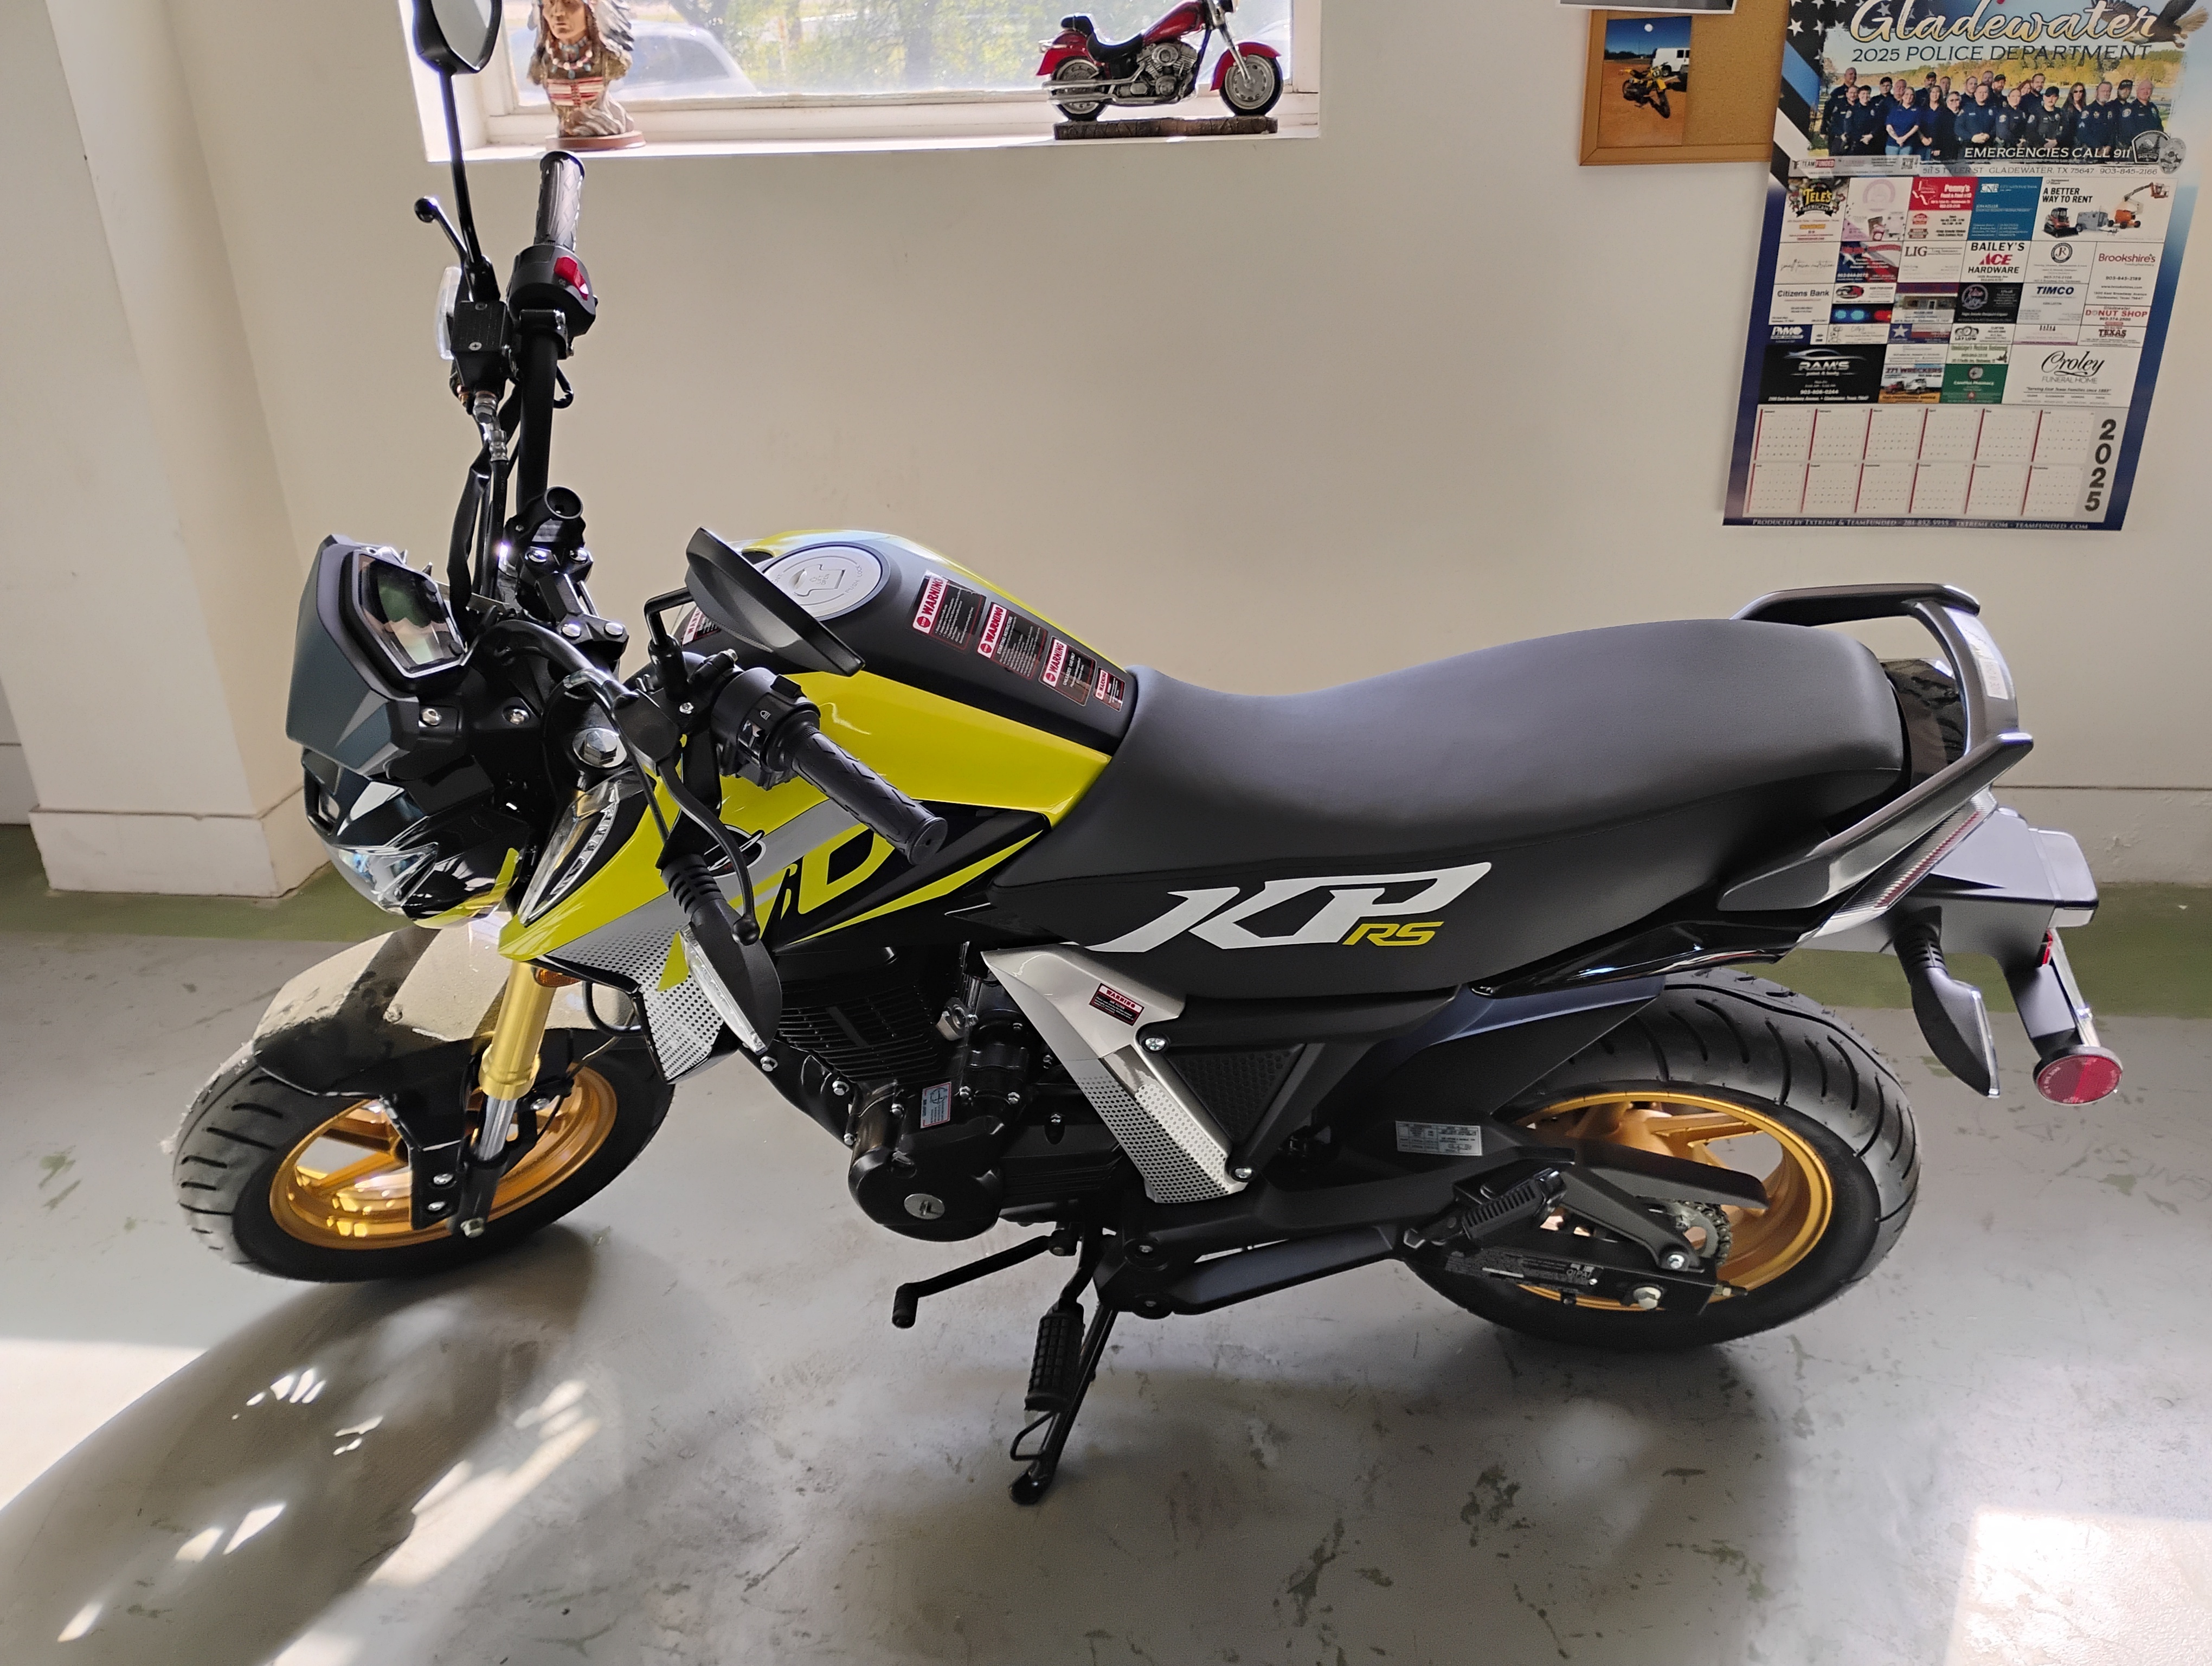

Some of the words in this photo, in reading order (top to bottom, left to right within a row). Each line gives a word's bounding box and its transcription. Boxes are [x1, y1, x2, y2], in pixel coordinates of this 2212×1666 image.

[1850, 0, 2158, 43] Gladewater
[1851, 48, 1900, 62] 2025
[1905, 46, 1984, 62] POLICE
[1990, 44, 2152, 60] DEPARTMENT
[1964, 147, 2069, 158] EMERGENCIES
[2072, 147, 2111, 158] CALL
[2113, 149, 2132, 158] 911
[1980, 184, 1999, 193] CNB
[2052, 188, 2080, 196] BETTER
[1904, 246, 1927, 257] LIG
[1970, 242, 2025, 252] BAILEY'S
[1979, 252, 2013, 265] ACE
[2098, 253, 2156, 263] Brookshire's
[2036, 286, 2074, 295] TIMCO
[1798, 360, 1850, 371] RAM'S
[2041, 350, 2105, 377] Croley
[2041, 375, 2073, 383] FUNERAL
[2085, 418, 2117, 512] 2025
[845, 580, 860, 593] PUSH
[921, 578, 944, 616] WARNING
[984, 606, 1004, 643] WARNING
[996, 636, 1007, 655] STARTING
[1048, 642, 1065, 674] WARNING
[1063, 667, 1072, 686] UNLEADED
[1099, 671, 1107, 691] WARNING
[1342, 921, 1444, 946] RS
[1105, 989, 1136, 1009] WARNING
